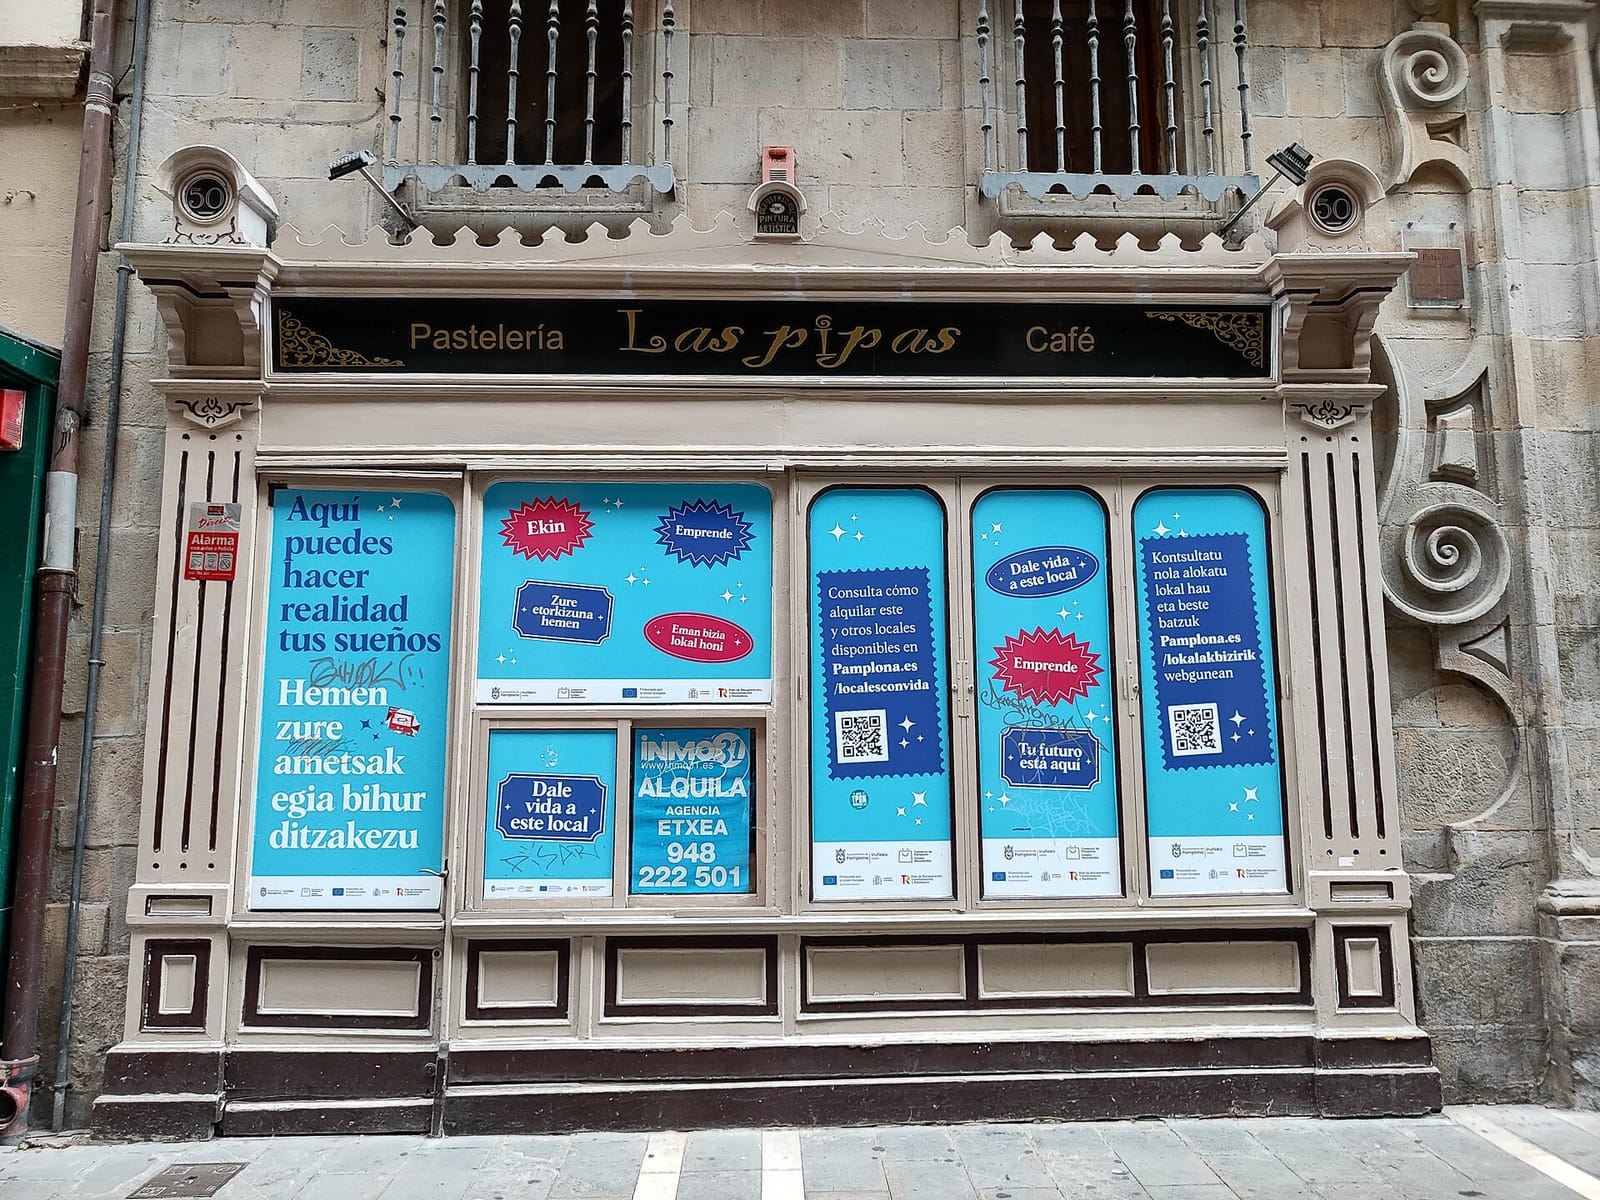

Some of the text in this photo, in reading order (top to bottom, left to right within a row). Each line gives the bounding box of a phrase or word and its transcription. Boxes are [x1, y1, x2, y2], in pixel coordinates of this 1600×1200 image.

[188, 187, 225, 210] 50
[1316, 198, 1351, 220] 50
[759, 215, 795, 223] PINTURA
[758, 224, 796, 232] ARTISTICA
[411, 323, 564, 350] Pastelería
[617, 309, 961, 367] Las pipas
[1025, 326, 1095, 353] Café
[286, 495, 360, 528] Aquí
[527, 519, 566, 536] Ekin
[675, 524, 733, 541] Emprende
[191, 534, 234, 545] Alarma
[283, 528, 393, 561] puedes
[1152, 549, 1222, 564] Kontsultatu
[1009, 555, 1070, 576] Dale vida
[1154, 566, 1227, 580] nola alokatu
[282, 561, 369, 588] hacer
[1009, 567, 1077, 590] a este local
[828, 585, 919, 599] Consulta cómo
[1155, 582, 1211, 596] lokal hau
[280, 595, 408, 622] realidad
[551, 594, 578, 608] Zure
[1157, 599, 1209, 612] eta beste
[532, 605, 593, 620] etorkizuna
[829, 604, 903, 620] alquilar este
[541, 616, 580, 630] hemen
[830, 622, 916, 639] y otros locales
[1158, 615, 1200, 629] batzuk
[279, 627, 441, 652] tus sueños
[671, 624, 726, 641] Eman bizia
[1160, 633, 1242, 648] Pamplona.es
[670, 635, 724, 652] lokal honi
[832, 642, 918, 658] disponibles en
[1013, 657, 1078, 673] Emprende
[1162, 648, 1257, 667] /lokalakbizirik
[832, 661, 918, 677] Pamplona.es
[1164, 668, 1234, 684] webgunean
[277, 679, 388, 706] Hemen
[833, 679, 930, 696] /localesconvida
[276, 720, 343, 740] zure
[1018, 742, 1083, 758] Tu futuro
[273, 746, 405, 775] ametsak
[1019, 756, 1081, 773] está aquí
[532, 781, 572, 798] Dale
[638, 777, 747, 798] ALQUILA
[271, 784, 426, 818] egia bihur
[525, 799, 576, 815] vida a
[666, 806, 720, 815] AGENCIA
[510, 816, 588, 832] este local
[658, 819, 728, 836] ETXEA
[269, 820, 418, 849] ditzakezu
[667, 842, 716, 863] 948
[638, 866, 740, 887] 222 501
